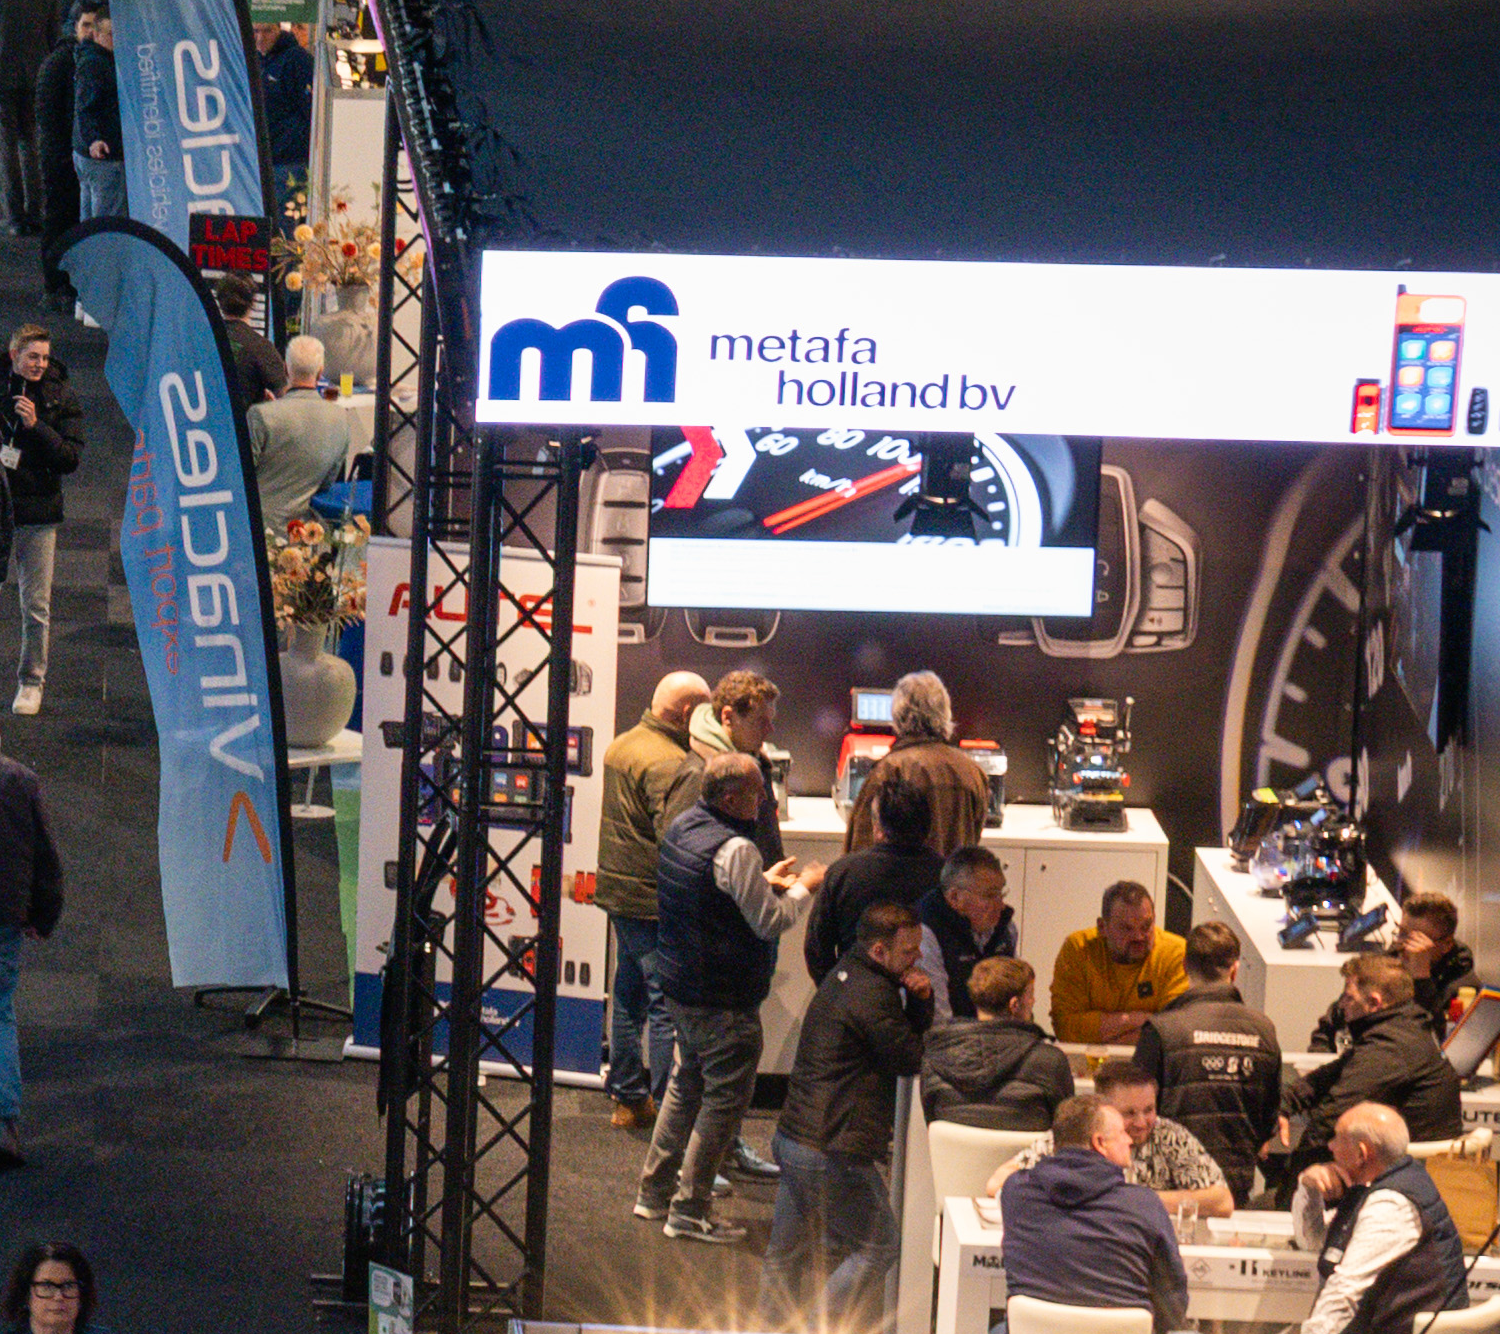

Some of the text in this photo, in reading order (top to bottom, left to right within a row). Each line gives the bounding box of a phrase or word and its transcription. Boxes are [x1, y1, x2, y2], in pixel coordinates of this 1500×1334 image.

[205, 219, 258, 243] LAP
[191, 244, 268, 271] TIMES
[709, 327, 876, 365] metafa
[777, 369, 1016, 412] holland bv
